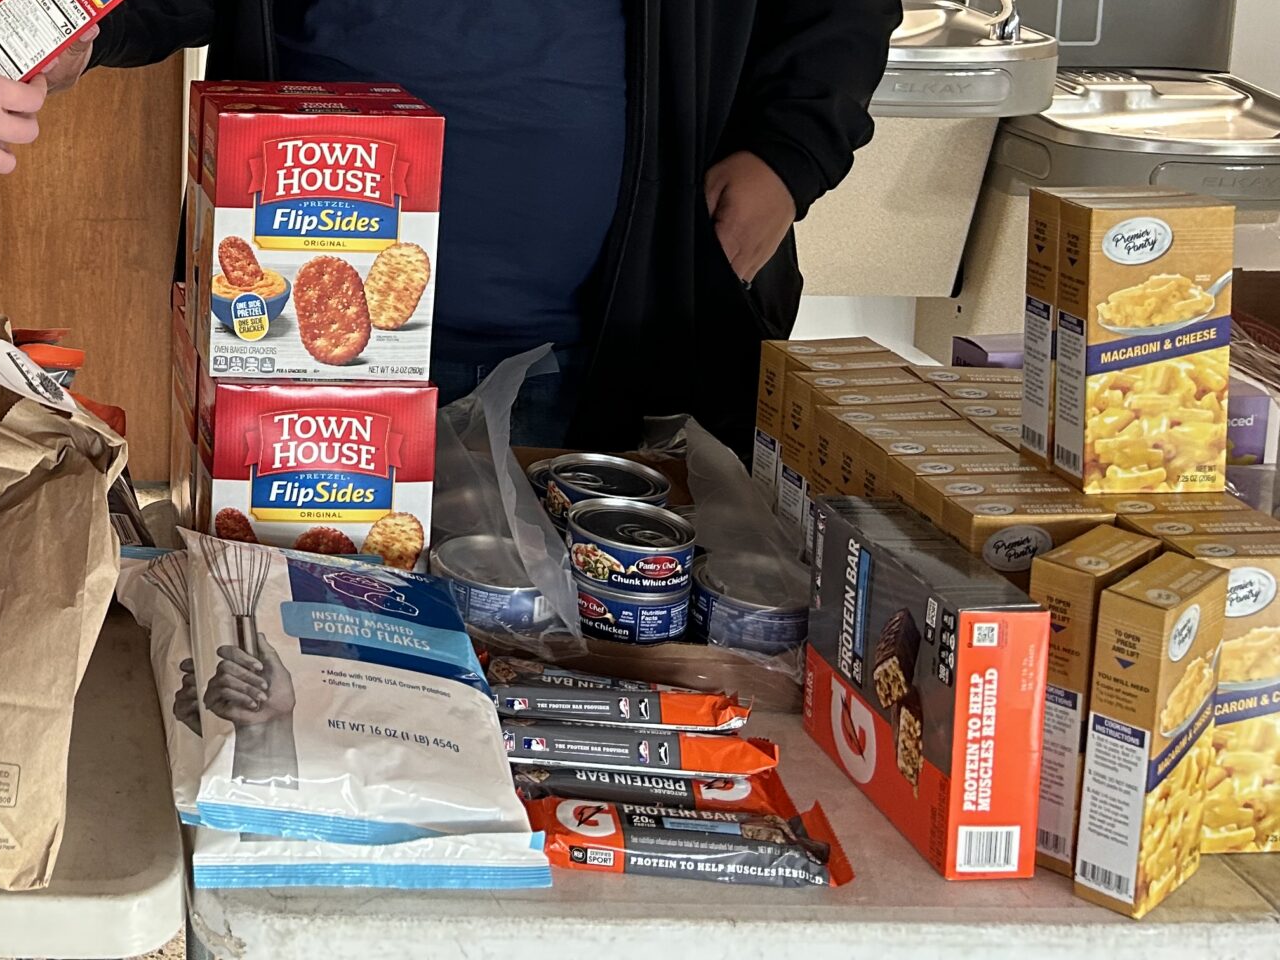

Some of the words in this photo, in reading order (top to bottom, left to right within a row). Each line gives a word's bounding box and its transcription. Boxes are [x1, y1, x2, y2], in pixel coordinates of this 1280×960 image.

[70, 0, 87, 20] Facts
[60, 21, 72, 35] 70
[278, 140, 378, 169] TOWN
[276, 168, 381, 199] HOUSE
[273, 208, 381, 235] FlipSides
[1112, 228, 1151, 247] Premier
[1123, 237, 1157, 255] Pantry
[236, 302, 247, 310] ONE
[248, 300, 261, 308] SIDE
[237, 308, 262, 318] PRETZEL
[239, 319, 250, 327] ONE
[250, 318, 262, 326] SIDE
[230, 346, 247, 354] BAKED
[248, 347, 277, 355] CRACKERS
[1100, 342, 1161, 364] MACARONI
[1164, 339, 1173, 349] &
[1175, 328, 1217, 347] CHEESE
[216, 357, 225, 365] 70
[391, 366, 399, 374] 9.2
[400, 366, 407, 374] OZ
[408, 367, 424, 375] (260g)
[274, 413, 373, 441] TOWN
[272, 442, 375, 470] HOUSE
[269, 481, 375, 506] FlipSides
[300, 511, 342, 519] ORIGINAL
[992, 536, 1032, 554] Premier
[846, 538, 860, 585] BAR
[1006, 546, 1038, 563] Pantry
[639, 562, 661, 571] Pantry
[612, 574, 641, 586] Chunk
[667, 574, 689, 585] Chicken
[588, 602, 605, 613] Chef
[312, 611, 360, 625] INSTANT
[364, 619, 414, 636] MASHED
[594, 621, 629, 636] Chicken
[841, 585, 856, 678] PROTEIN
[314, 621, 371, 638] POTATO
[377, 631, 430, 651] FLAKES
[1116, 638, 1136, 649] PRESS
[1124, 631, 1140, 642] OPEN
[1112, 645, 1125, 656] AND
[1127, 648, 1140, 659] LIFT
[327, 670, 347, 678] Made
[365, 675, 383, 684] 100%
[385, 678, 397, 686] USA
[398, 681, 420, 691] Grown
[421, 685, 451, 698] Potatoes
[328, 679, 350, 688] Gluten
[352, 682, 367, 690] Free
[541, 675, 574, 687] BAR
[806, 672, 814, 705] BARS
[1098, 672, 1112, 680] YOU
[1113, 677, 1129, 688] WILL
[969, 673, 984, 716] HELP
[981, 668, 998, 736] REBUILD
[1214, 697, 1257, 716] CARONI
[328, 719, 346, 729] NET
[348, 722, 365, 732] WT
[370, 725, 382, 735] 16
[384, 728, 398, 739] OZ
[401, 732, 410, 741] (1
[414, 734, 430, 746] LB)
[432, 738, 460, 753] 454g
[831, 673, 877, 784] G
[968, 718, 981, 740] TO
[1096, 724, 1140, 745] INSTRUCTIONS
[1105, 720, 1131, 734] COOKING
[603, 746, 629, 754] PROVIDER
[576, 770, 610, 782] BAR
[615, 773, 686, 791] PROTEIN
[963, 743, 979, 812] PROTEIN
[978, 739, 995, 812] MUSCLES
[622, 804, 698, 818] PROTEIN
[700, 811, 738, 822] BAR
[588, 856, 612, 864] SPORT
[630, 856, 677, 868] PROTEIN
[681, 861, 695, 870] TO
[697, 863, 724, 872] HELP
[727, 864, 776, 877] MUSCLES
[778, 868, 824, 884] REBUILD
